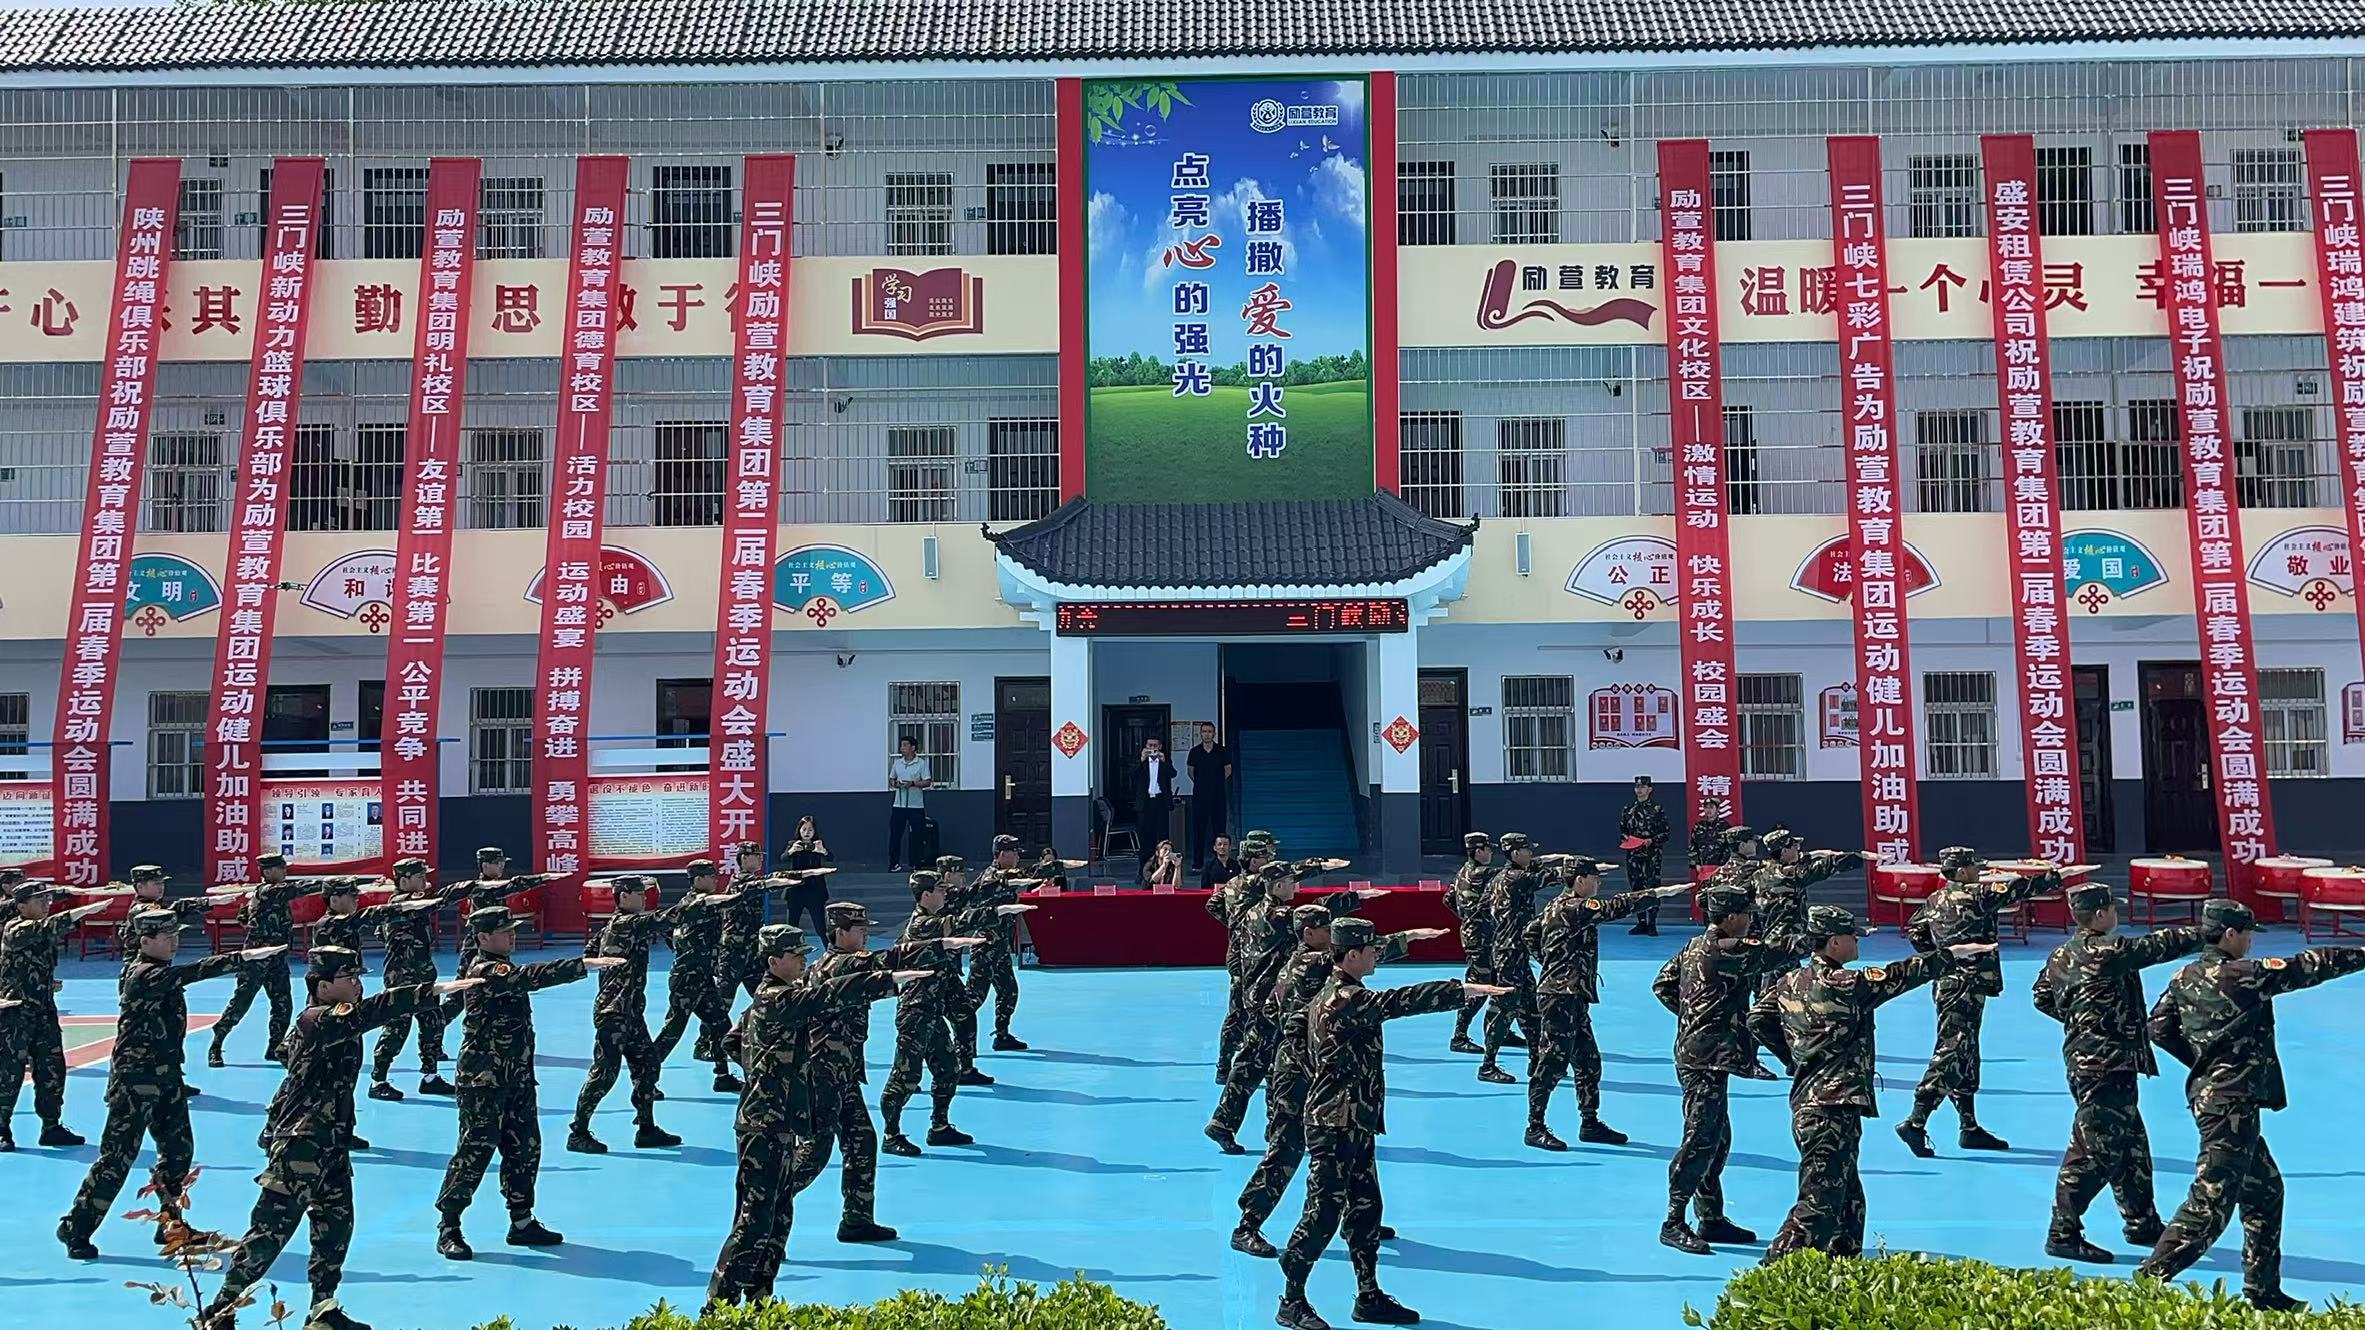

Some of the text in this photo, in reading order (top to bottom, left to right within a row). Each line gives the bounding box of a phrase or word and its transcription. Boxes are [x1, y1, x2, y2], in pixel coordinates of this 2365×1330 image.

[0, 287, 79, 337] 心
[353, 284, 542, 334] 勤思
[881, 273, 912, 320] 学习 强国
[1163, 153, 1221, 397] 点亮心的强光
[1522, 264, 1656, 291] 励萱教育
[1241, 201, 1291, 459] 播撒爱的火种
[63, 207, 164, 885] 陕州跳绳俱乐部祝励萱教育集团第二届春季运动会圆满成功
[215, 204, 310, 883] 三门峡新动力篮球俱乐部为励萱教育集团运动健儿加油助威
[1840, 184, 1912, 865] 三门峡七彩广告为励萱教育集团运动健儿加油助威
[1994, 180, 2076, 865] 盛安租赁公司祝励萱教育集团第二届春季运动会圆满成功
[2164, 178, 2268, 866] 三门峡瑞鸿电子祝励萱教育集团第二届春季运动会圆满成功
[2283, 541, 2350, 552] 社会主义核心价值
[2287, 555, 2351, 576] 敬业
[126, 581, 183, 602] 文明
[342, 566, 396, 576] 社会主义核心
[403, 552, 441, 643] 比赛第二
[552, 561, 591, 649] 运动盛宴
[611, 574, 628, 595] 由
[790, 573, 853, 594] 平等
[1608, 565, 1671, 585] 公正
[1687, 554, 1724, 643] 快乐成长
[1833, 562, 1852, 583] 法
[2063, 558, 2123, 580] 爱国
[394, 660, 433, 761] 公平竞争
[544, 666, 583, 758] 拼搏奋进
[1692, 660, 1730, 749] 校园盛会
[395, 779, 429, 860] 共同进
[544, 780, 579, 873] 勇攀高峰
